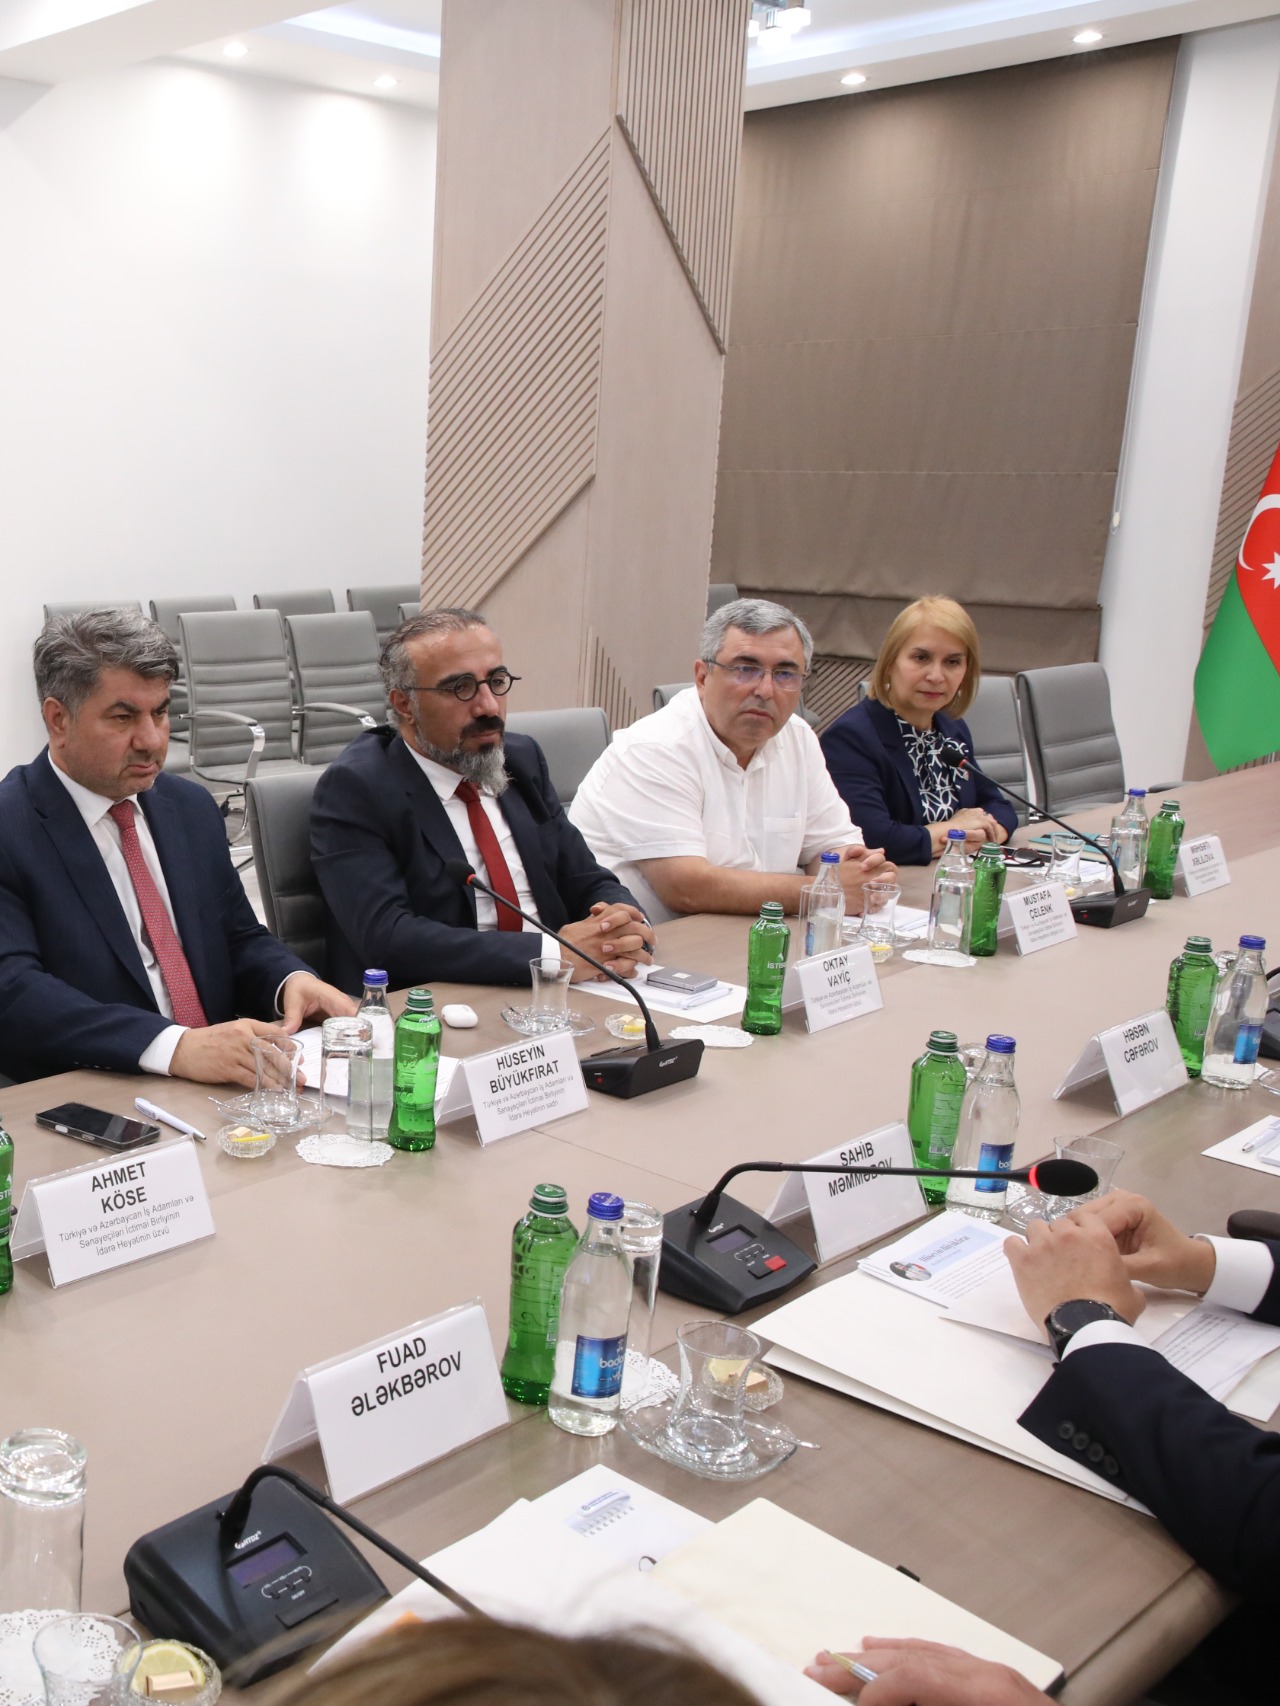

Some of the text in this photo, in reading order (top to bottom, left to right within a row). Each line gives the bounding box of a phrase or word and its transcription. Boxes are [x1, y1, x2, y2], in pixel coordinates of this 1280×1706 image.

[1023, 890, 1052, 906] MUSTAFA
[1029, 904, 1054, 920] ÇELENK
[822, 955, 849, 972] OKTAY
[827, 970, 851, 988] VAYİÇ
[1122, 1022, 1149, 1043] HƏSƏN
[496, 1044, 546, 1071] HÜSEYİN
[1124, 1038, 1158, 1063] CƏFƏROV
[489, 1060, 560, 1094] BÜYÜKFIRAT
[840, 1141, 874, 1166] SAHİB
[91, 1161, 146, 1192] AHMET
[101, 1186, 148, 1214] KÖSE
[376, 1337, 426, 1373] FUAD
[351, 1351, 462, 1417] ƏLƏKBƏROV
